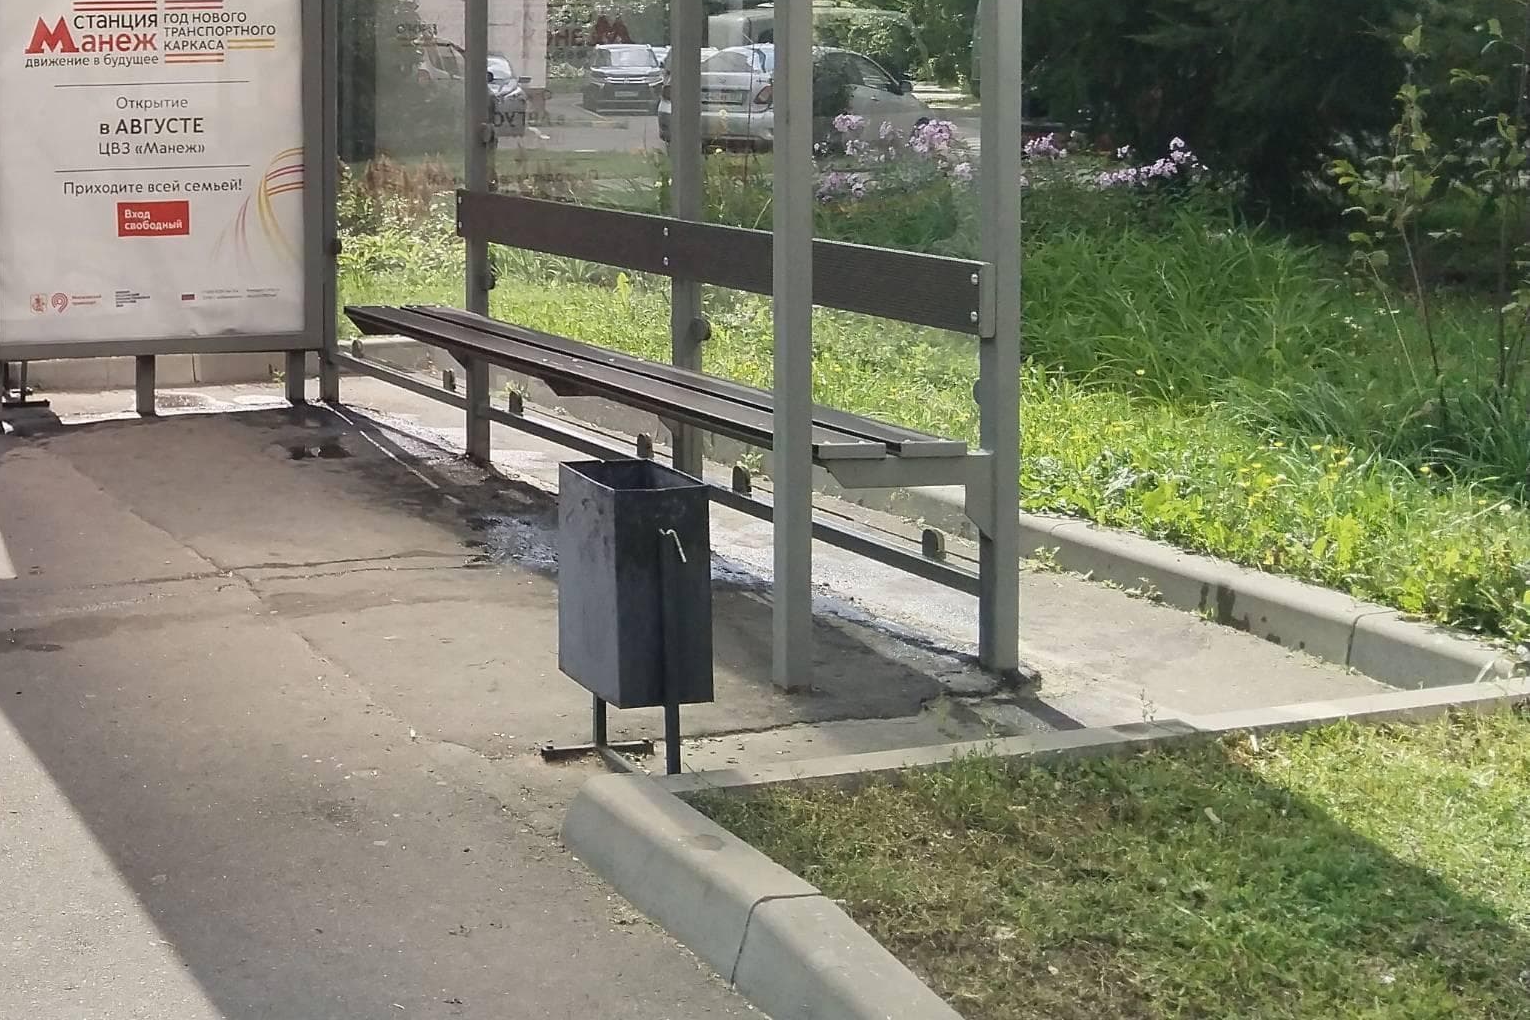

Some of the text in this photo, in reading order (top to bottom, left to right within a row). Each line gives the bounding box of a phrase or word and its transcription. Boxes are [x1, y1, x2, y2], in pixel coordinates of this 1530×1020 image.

[164, 12, 247, 24] ГОД НОВОГО
[24, 16, 158, 55] Манеж
[164, 25, 276, 37] ТРАНСПОРТНОГО
[164, 39, 224, 51] КАРКАСА
[25, 53, 159, 68] движение в будущее
[116, 96, 189, 111] Открытие
[99, 117, 205, 135] в АВГУСТЕ
[98, 141, 205, 156] ЦВЗ «Манеж»
[63, 179, 242, 195] Приходите всей семьей!
[124, 209, 151, 220] Вход
[124, 218, 183, 230] свободный
